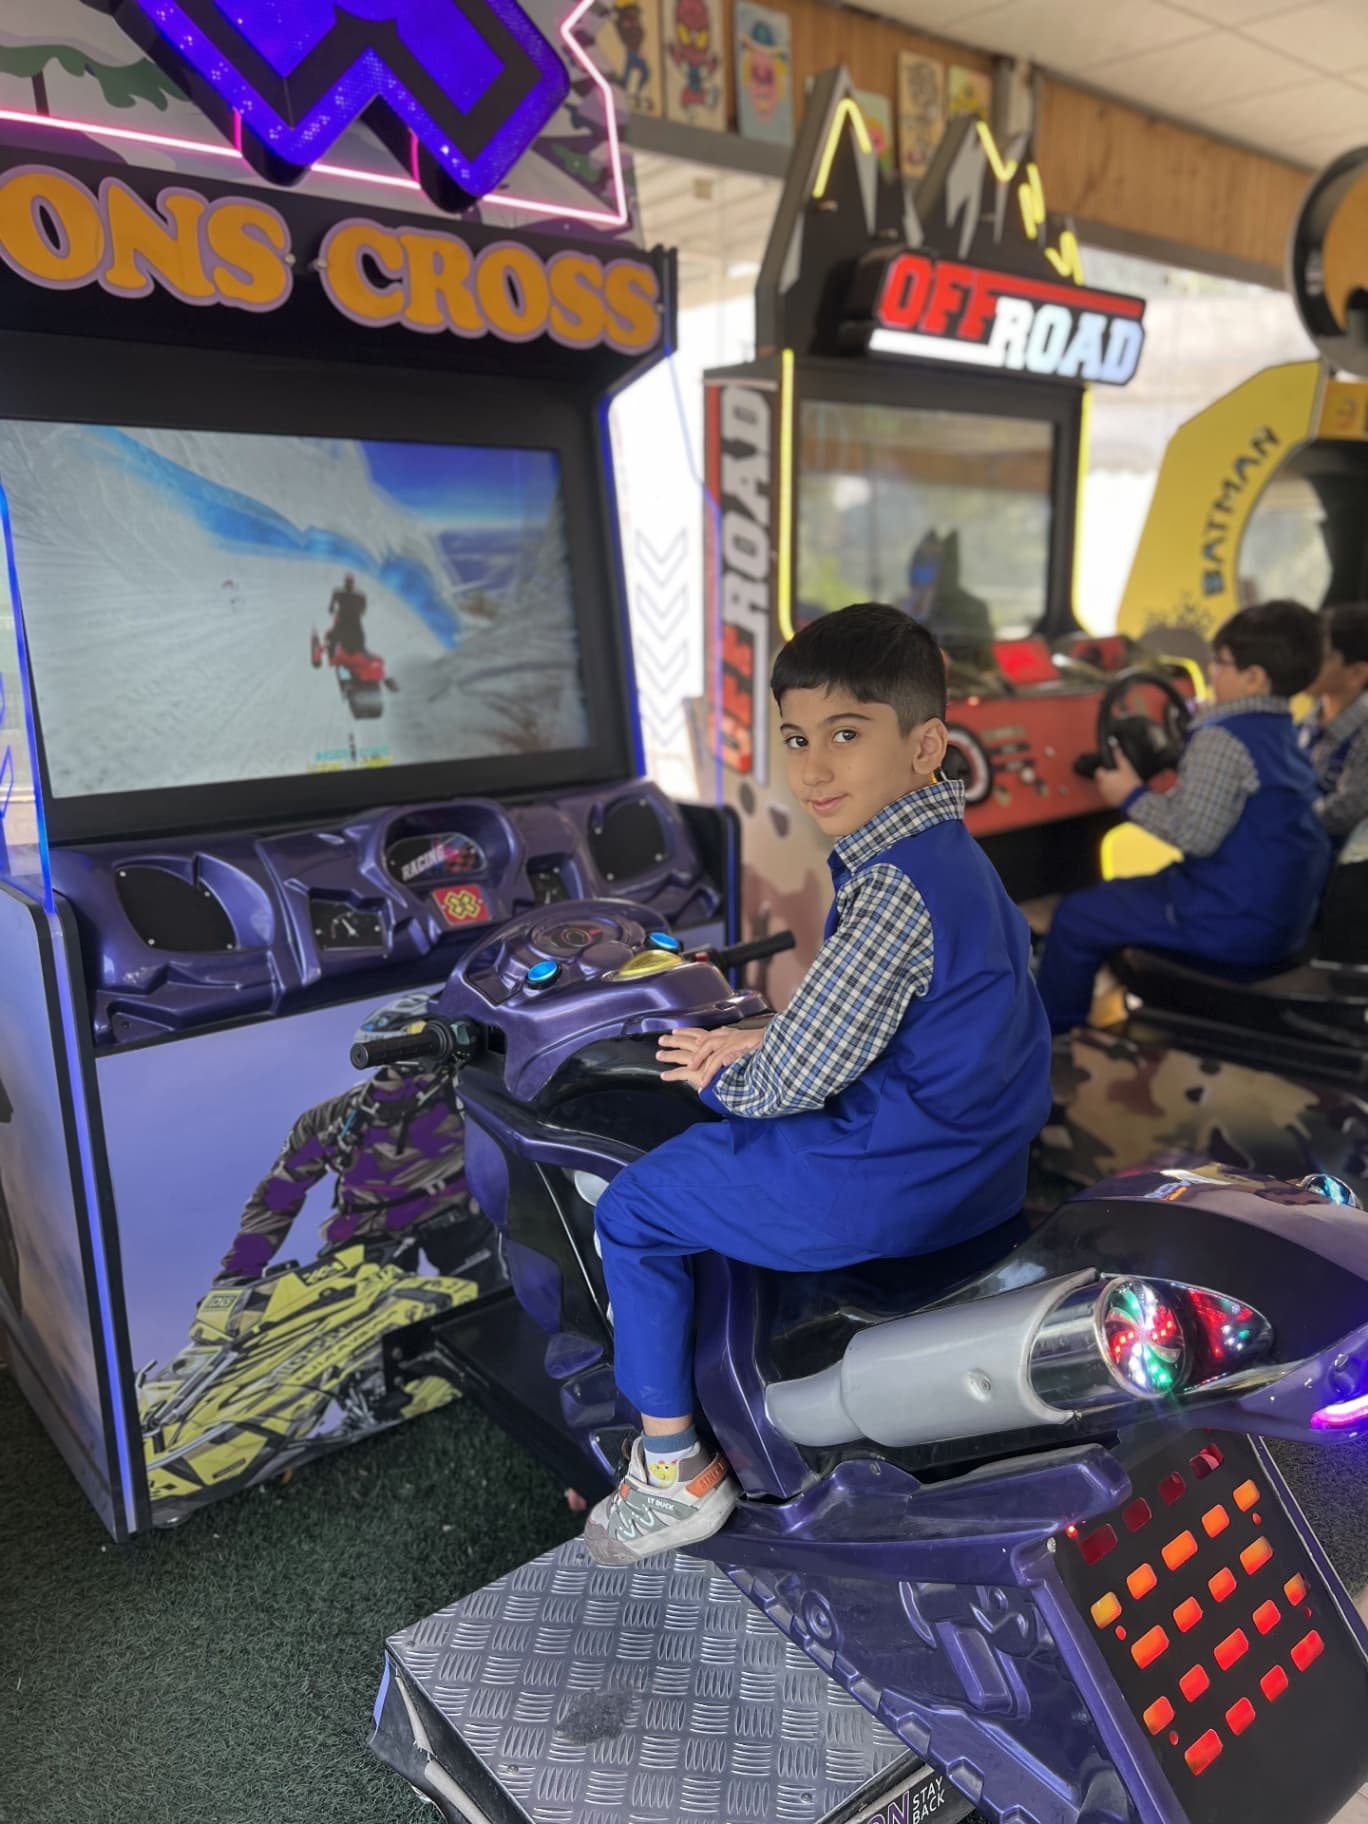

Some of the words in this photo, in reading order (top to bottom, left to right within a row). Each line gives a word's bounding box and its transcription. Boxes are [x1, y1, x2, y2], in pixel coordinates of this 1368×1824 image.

[0, 164, 293, 313] ONS
[318, 217, 663, 355] CROSS
[878, 253, 998, 341] OFF
[993, 296, 1146, 386] ROAD
[720, 386, 771, 636] ROAD
[1202, 424, 1280, 598] BATMAN
[912, 1776, 943, 1811] STAY
[912, 1790, 945, 1824] BACK
